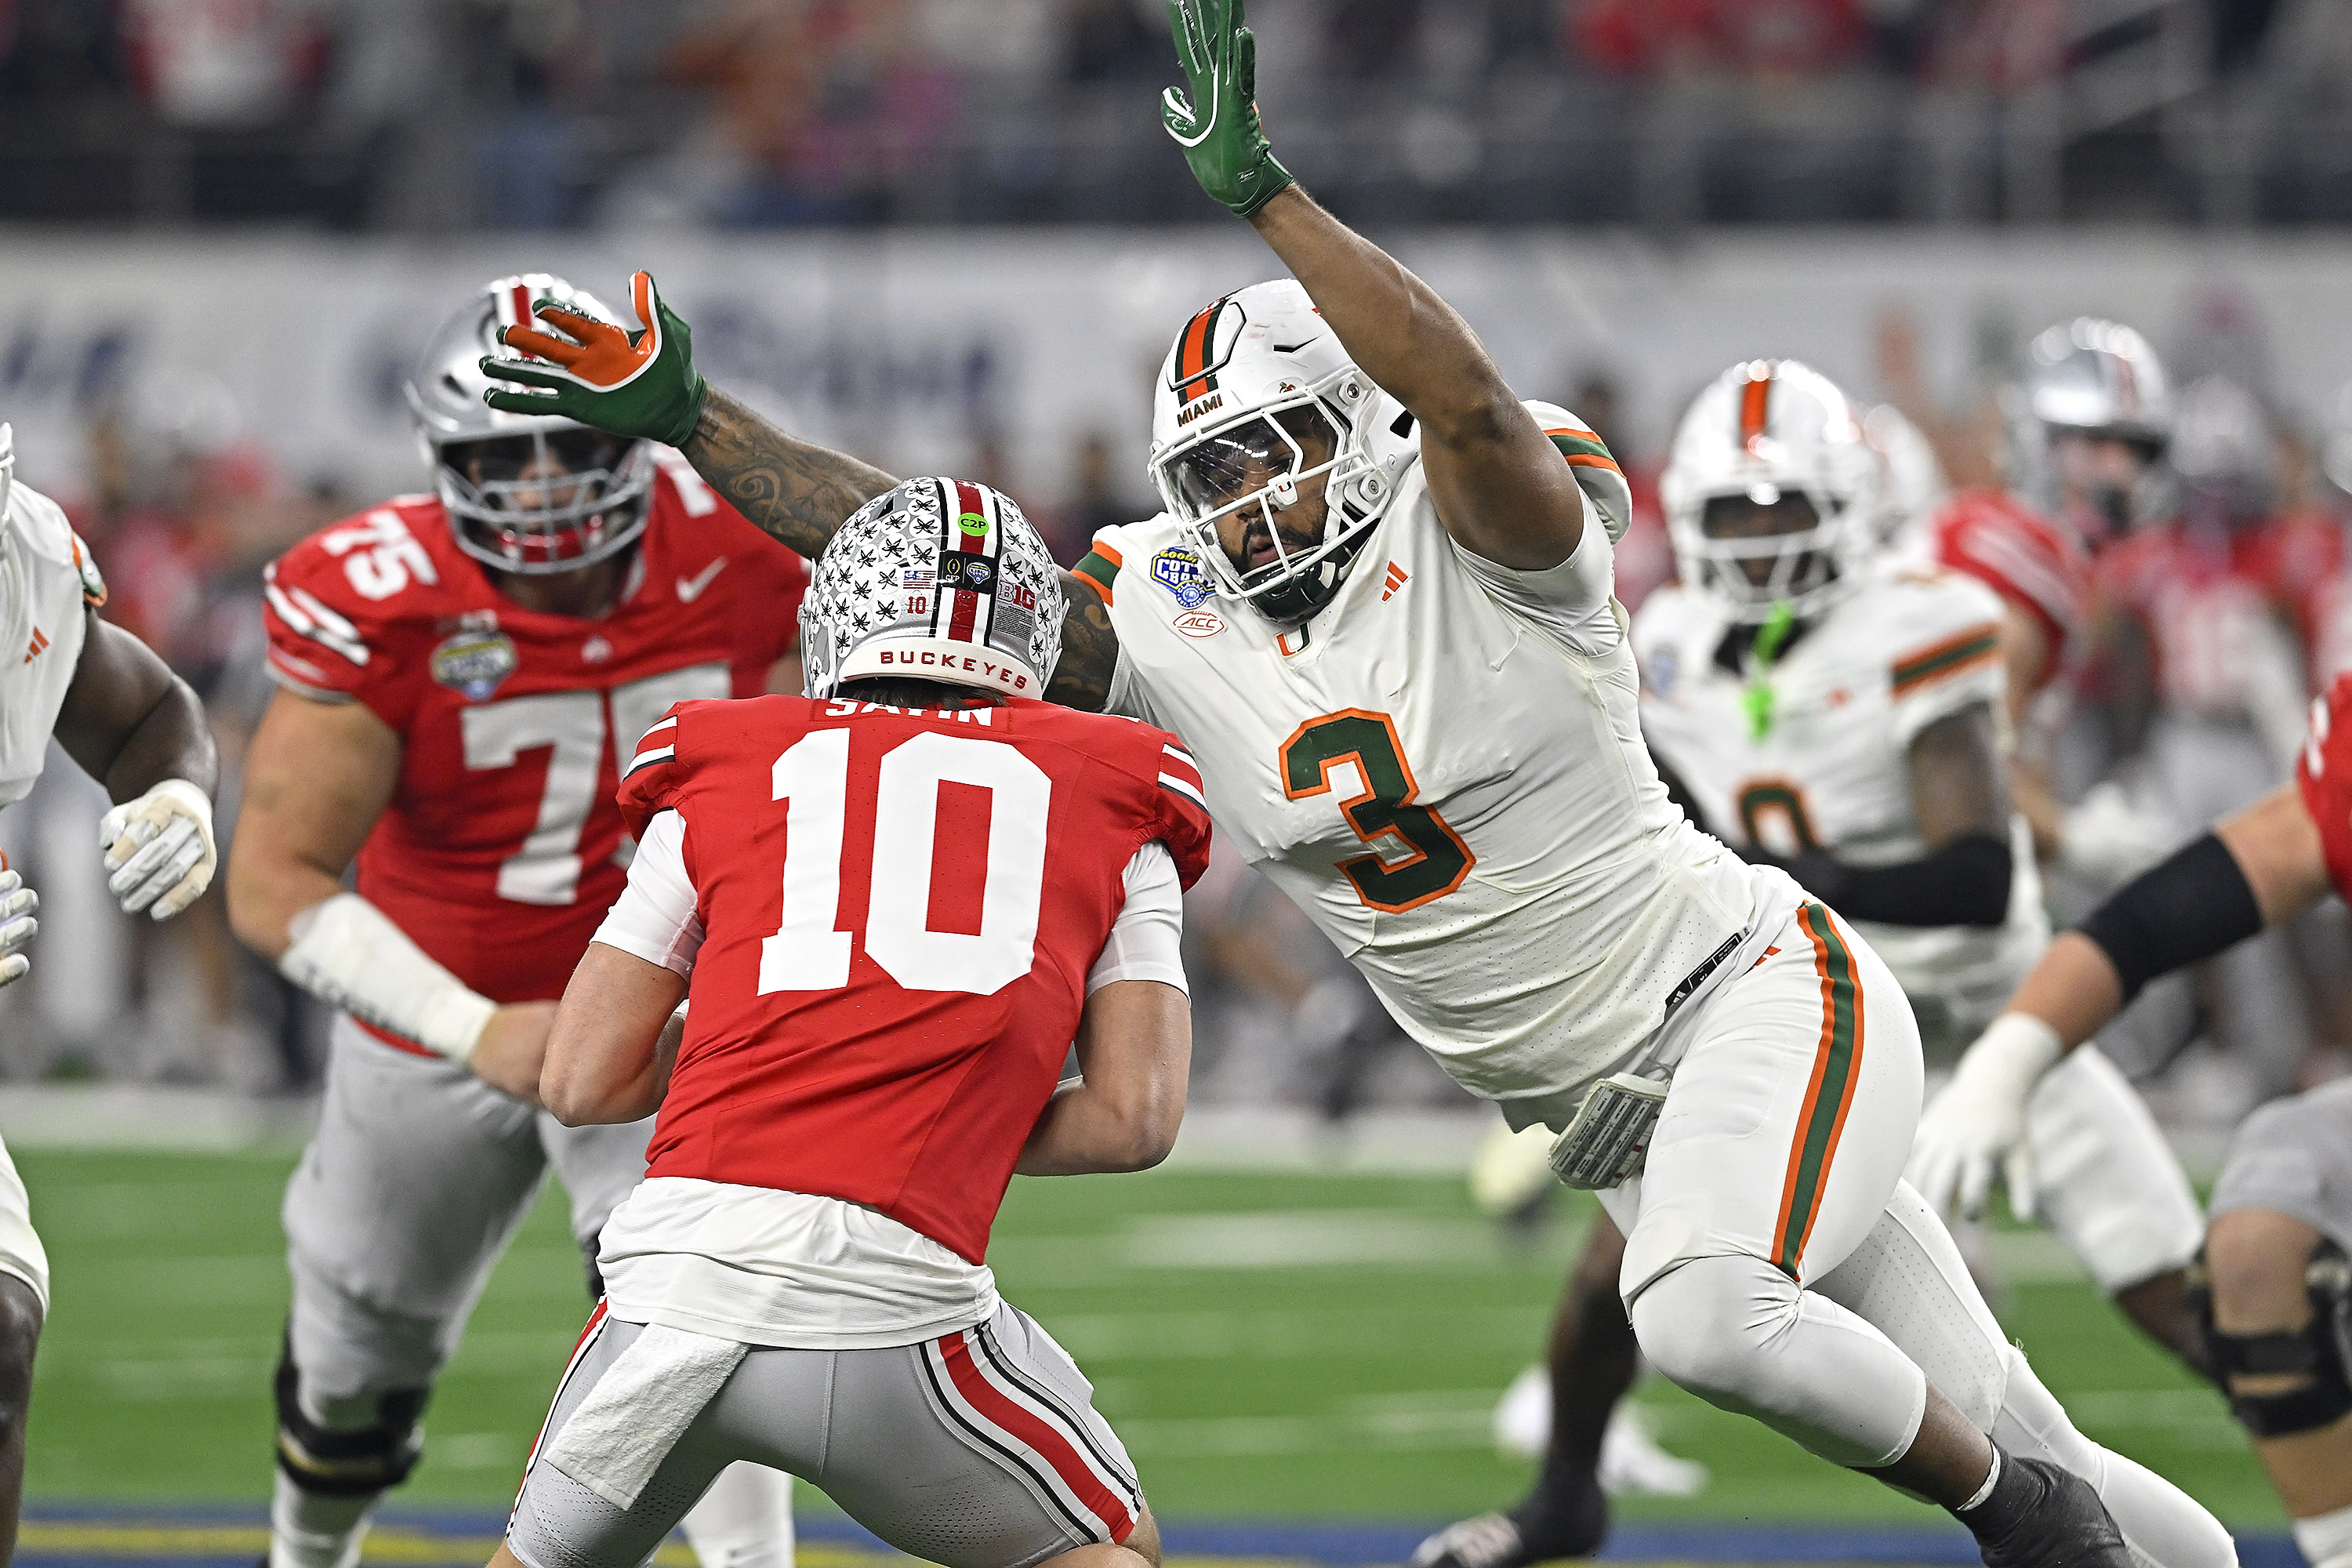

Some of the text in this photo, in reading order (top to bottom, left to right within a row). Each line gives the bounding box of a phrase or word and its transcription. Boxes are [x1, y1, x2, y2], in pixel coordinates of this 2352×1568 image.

[1177, 394, 1223, 427] MIAMI
[960, 518, 986, 529] C2P
[322, 510, 439, 601] 75
[1156, 558, 1197, 579] COT
[907, 596, 927, 614] 10
[997, 580, 1036, 610] BIG
[1181, 617, 1218, 628] ACC
[880, 652, 1028, 689] BUCKEYES
[1279, 707, 1477, 914] 3
[757, 727, 1052, 996] 10
